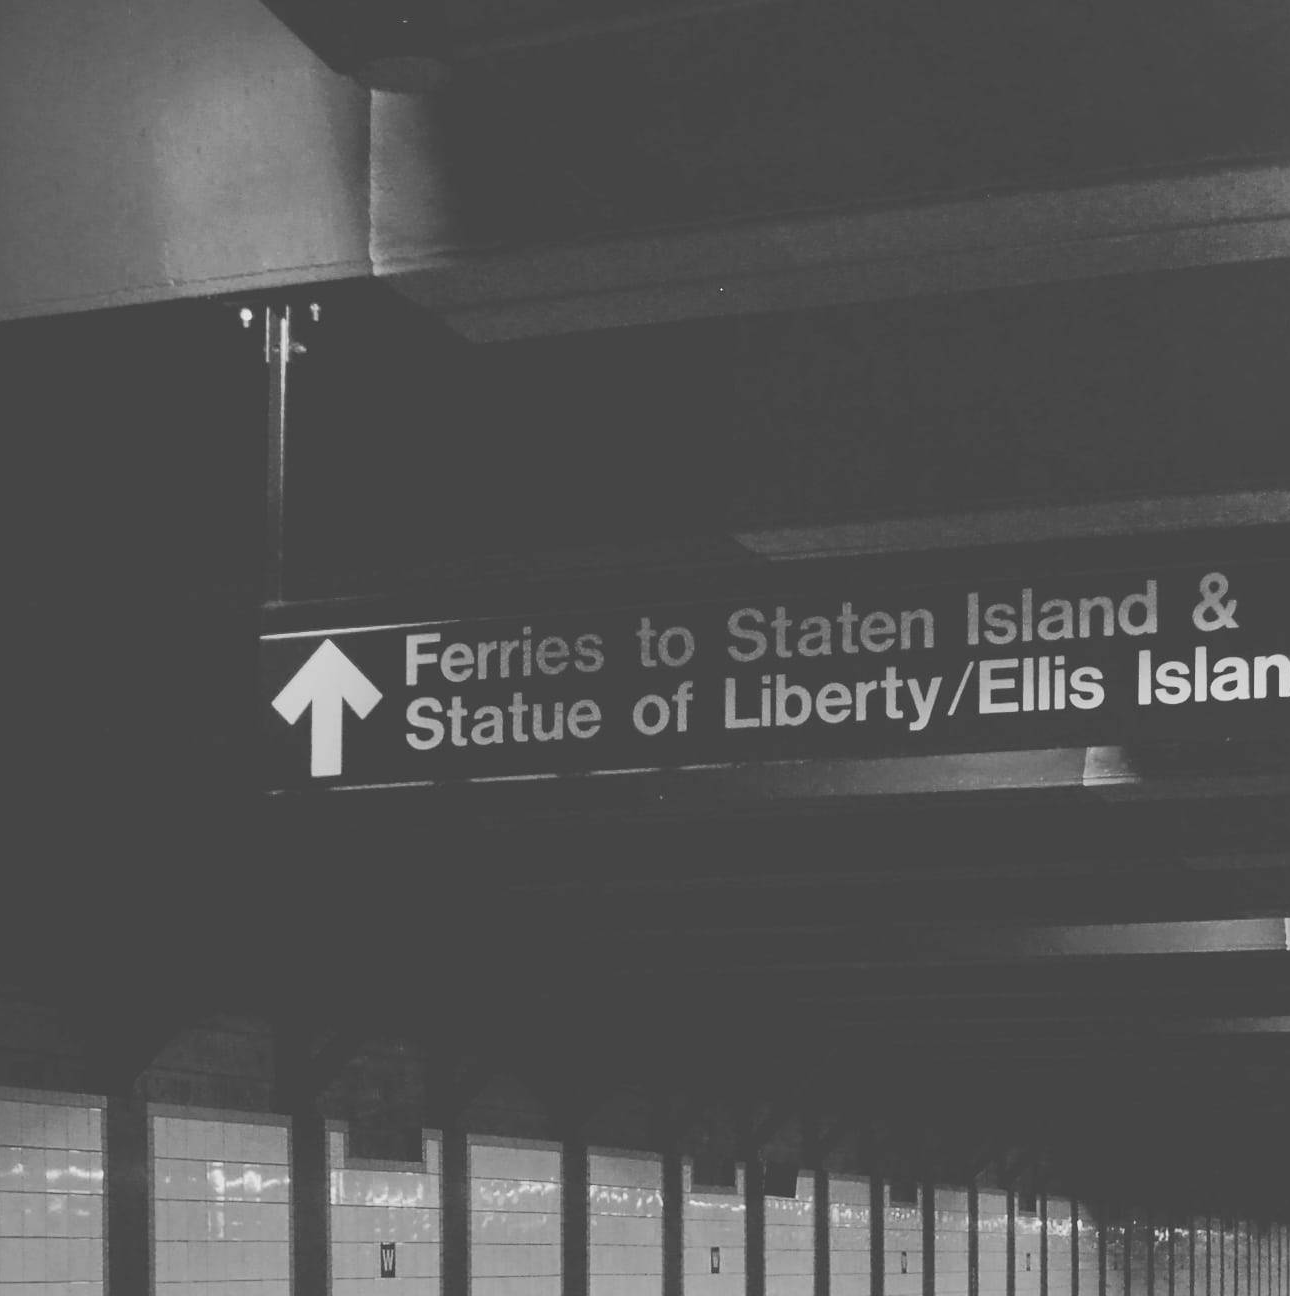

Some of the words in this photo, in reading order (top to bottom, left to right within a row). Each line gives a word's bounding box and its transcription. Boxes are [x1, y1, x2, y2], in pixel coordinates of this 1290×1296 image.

[405, 625, 605, 687] Ferries
[635, 616, 696, 668] to
[726, 601, 935, 662] Staten
[966, 579, 1158, 647] Island
[1192, 566, 1240, 632] &
[405, 692, 602, 751] Statue
[632, 680, 694, 737] of
[724, 655, 1106, 732] Liberty/Ellis
[381, 1249, 394, 1272] W
